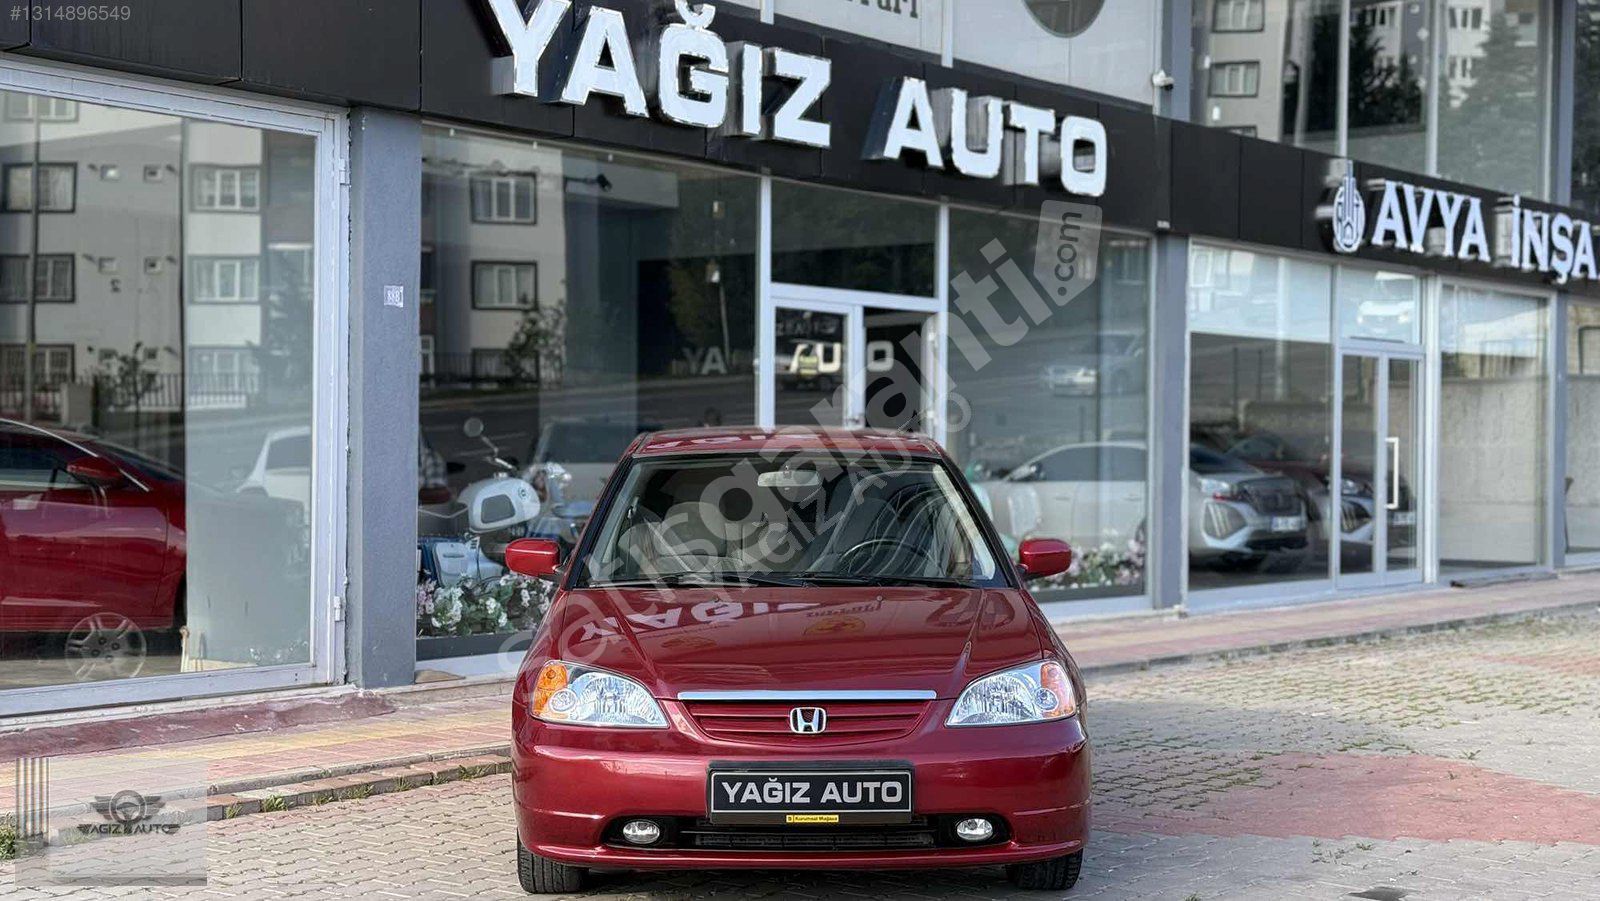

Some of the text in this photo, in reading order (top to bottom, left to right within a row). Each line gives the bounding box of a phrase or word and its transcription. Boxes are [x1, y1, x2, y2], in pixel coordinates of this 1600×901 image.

[489, 0, 1108, 197] YAĞIZ AUTO
[1371, 180, 1600, 285] AVYA İNŞA
[721, 777, 902, 803] YAĞIZ AUTO
